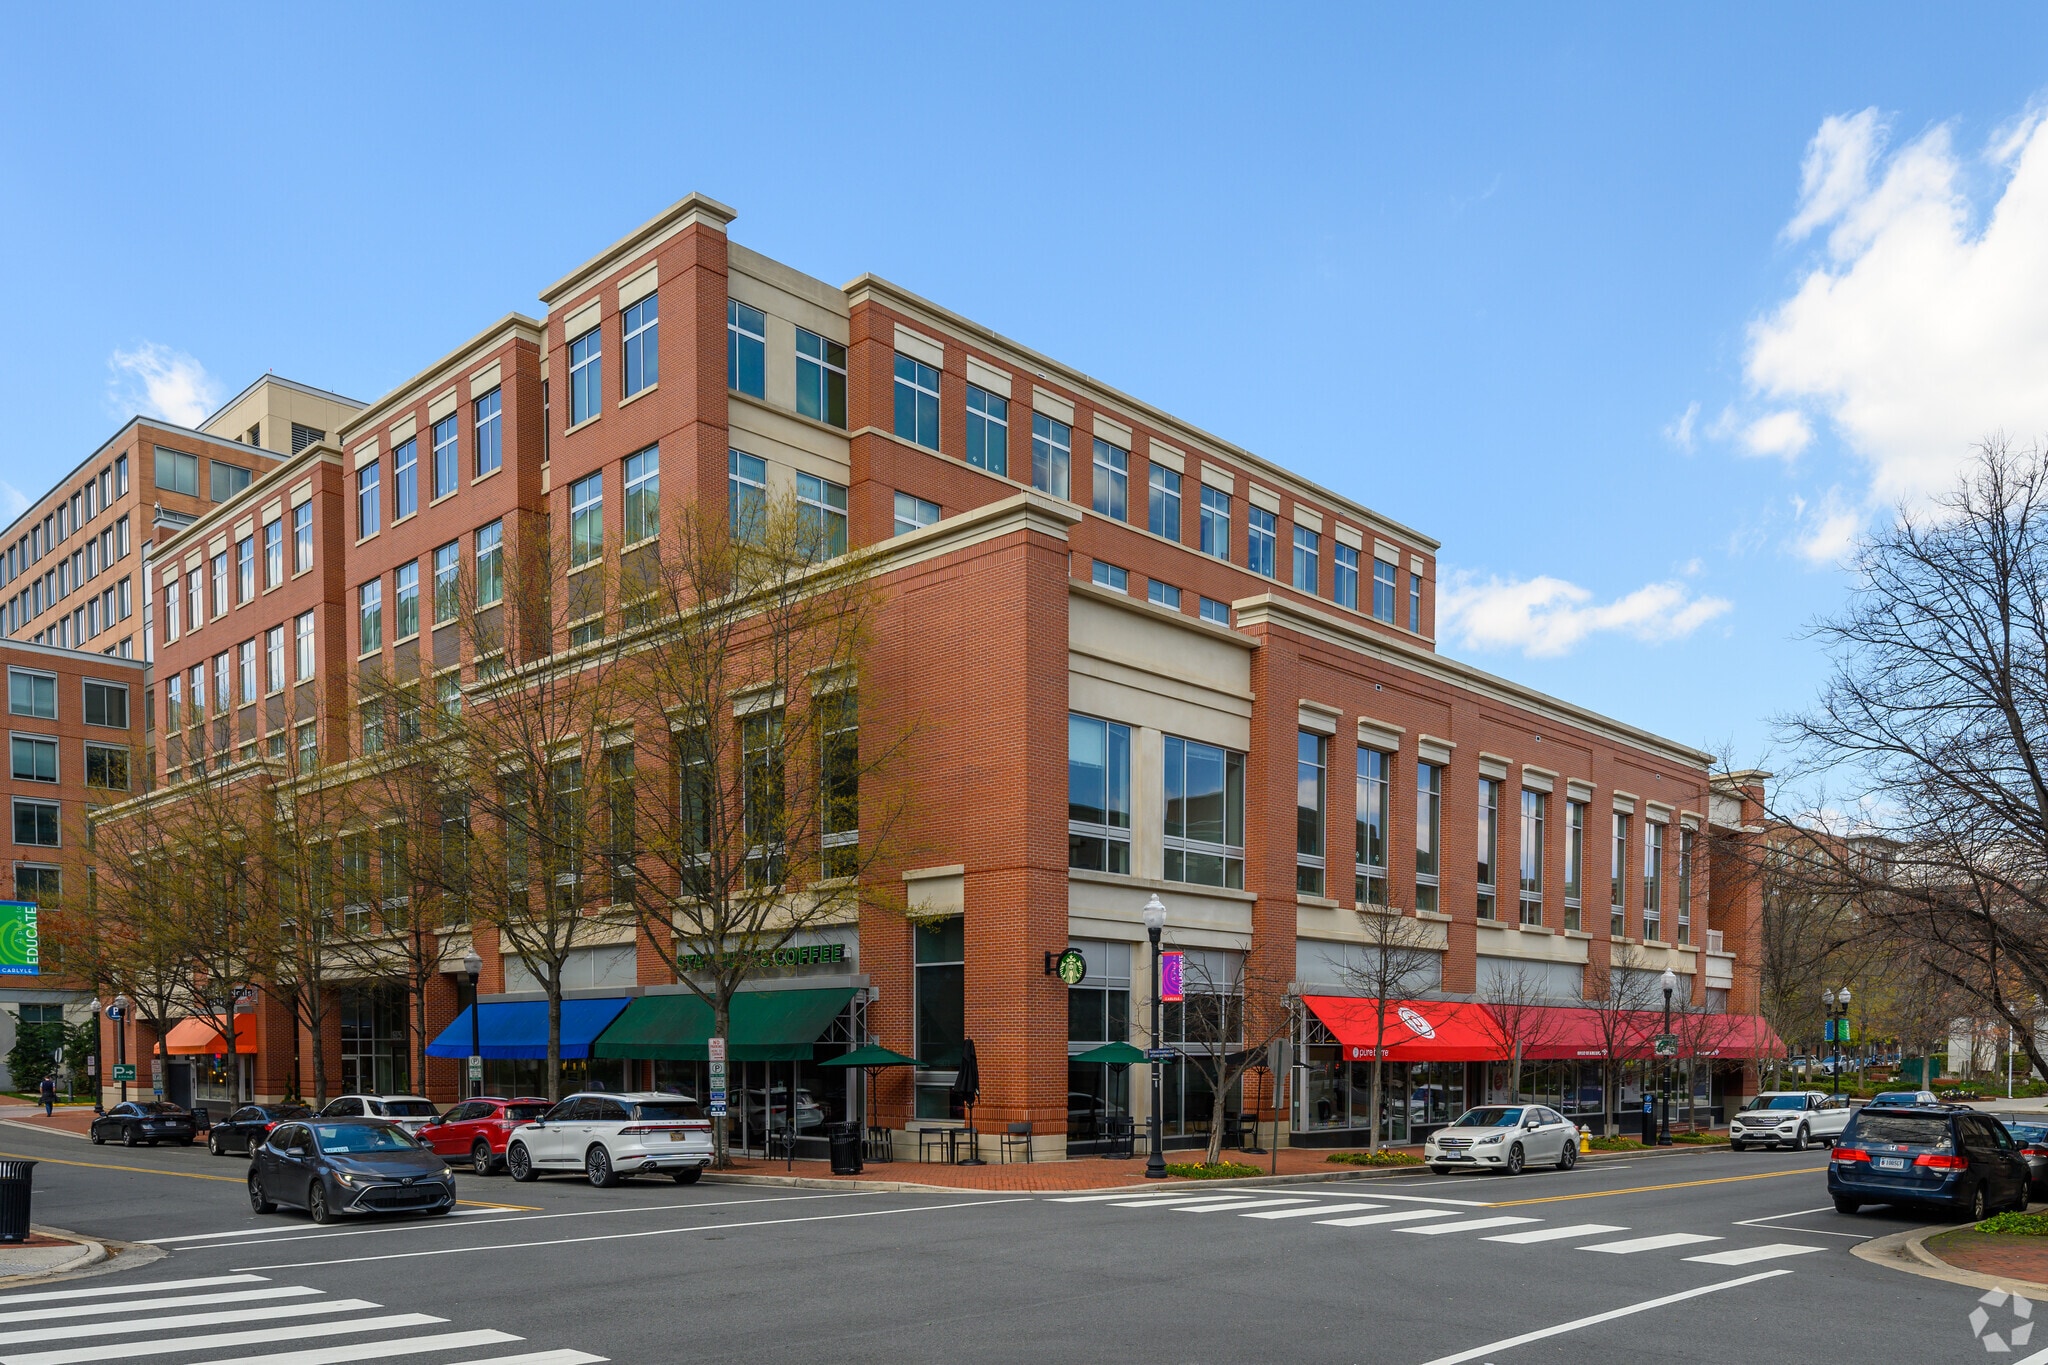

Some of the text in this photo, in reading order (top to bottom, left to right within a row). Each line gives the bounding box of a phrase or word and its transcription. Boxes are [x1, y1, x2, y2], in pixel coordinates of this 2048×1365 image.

[25, 906, 38, 965] EDUCATE
[677, 944, 844, 971] STAUS COFFEE
[113, 1007, 119, 1015] P
[1360, 1048, 1389, 1058] pure brre
[114, 1066, 125, 1078] P
